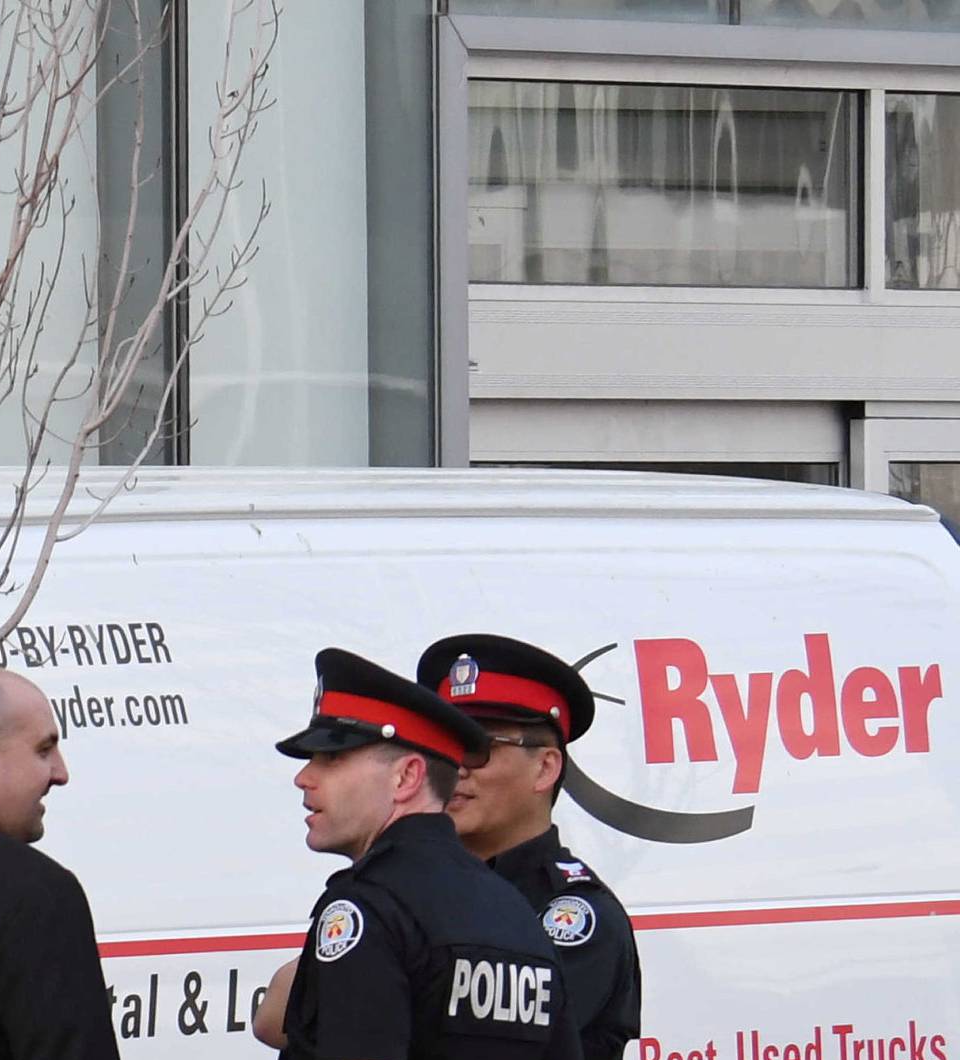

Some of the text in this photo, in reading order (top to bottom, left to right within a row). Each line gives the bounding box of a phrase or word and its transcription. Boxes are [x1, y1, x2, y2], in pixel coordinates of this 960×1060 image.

[634, 633, 943, 794] Ryder
[178, 971, 208, 1035] &
[448, 958, 551, 1026] POLICE
